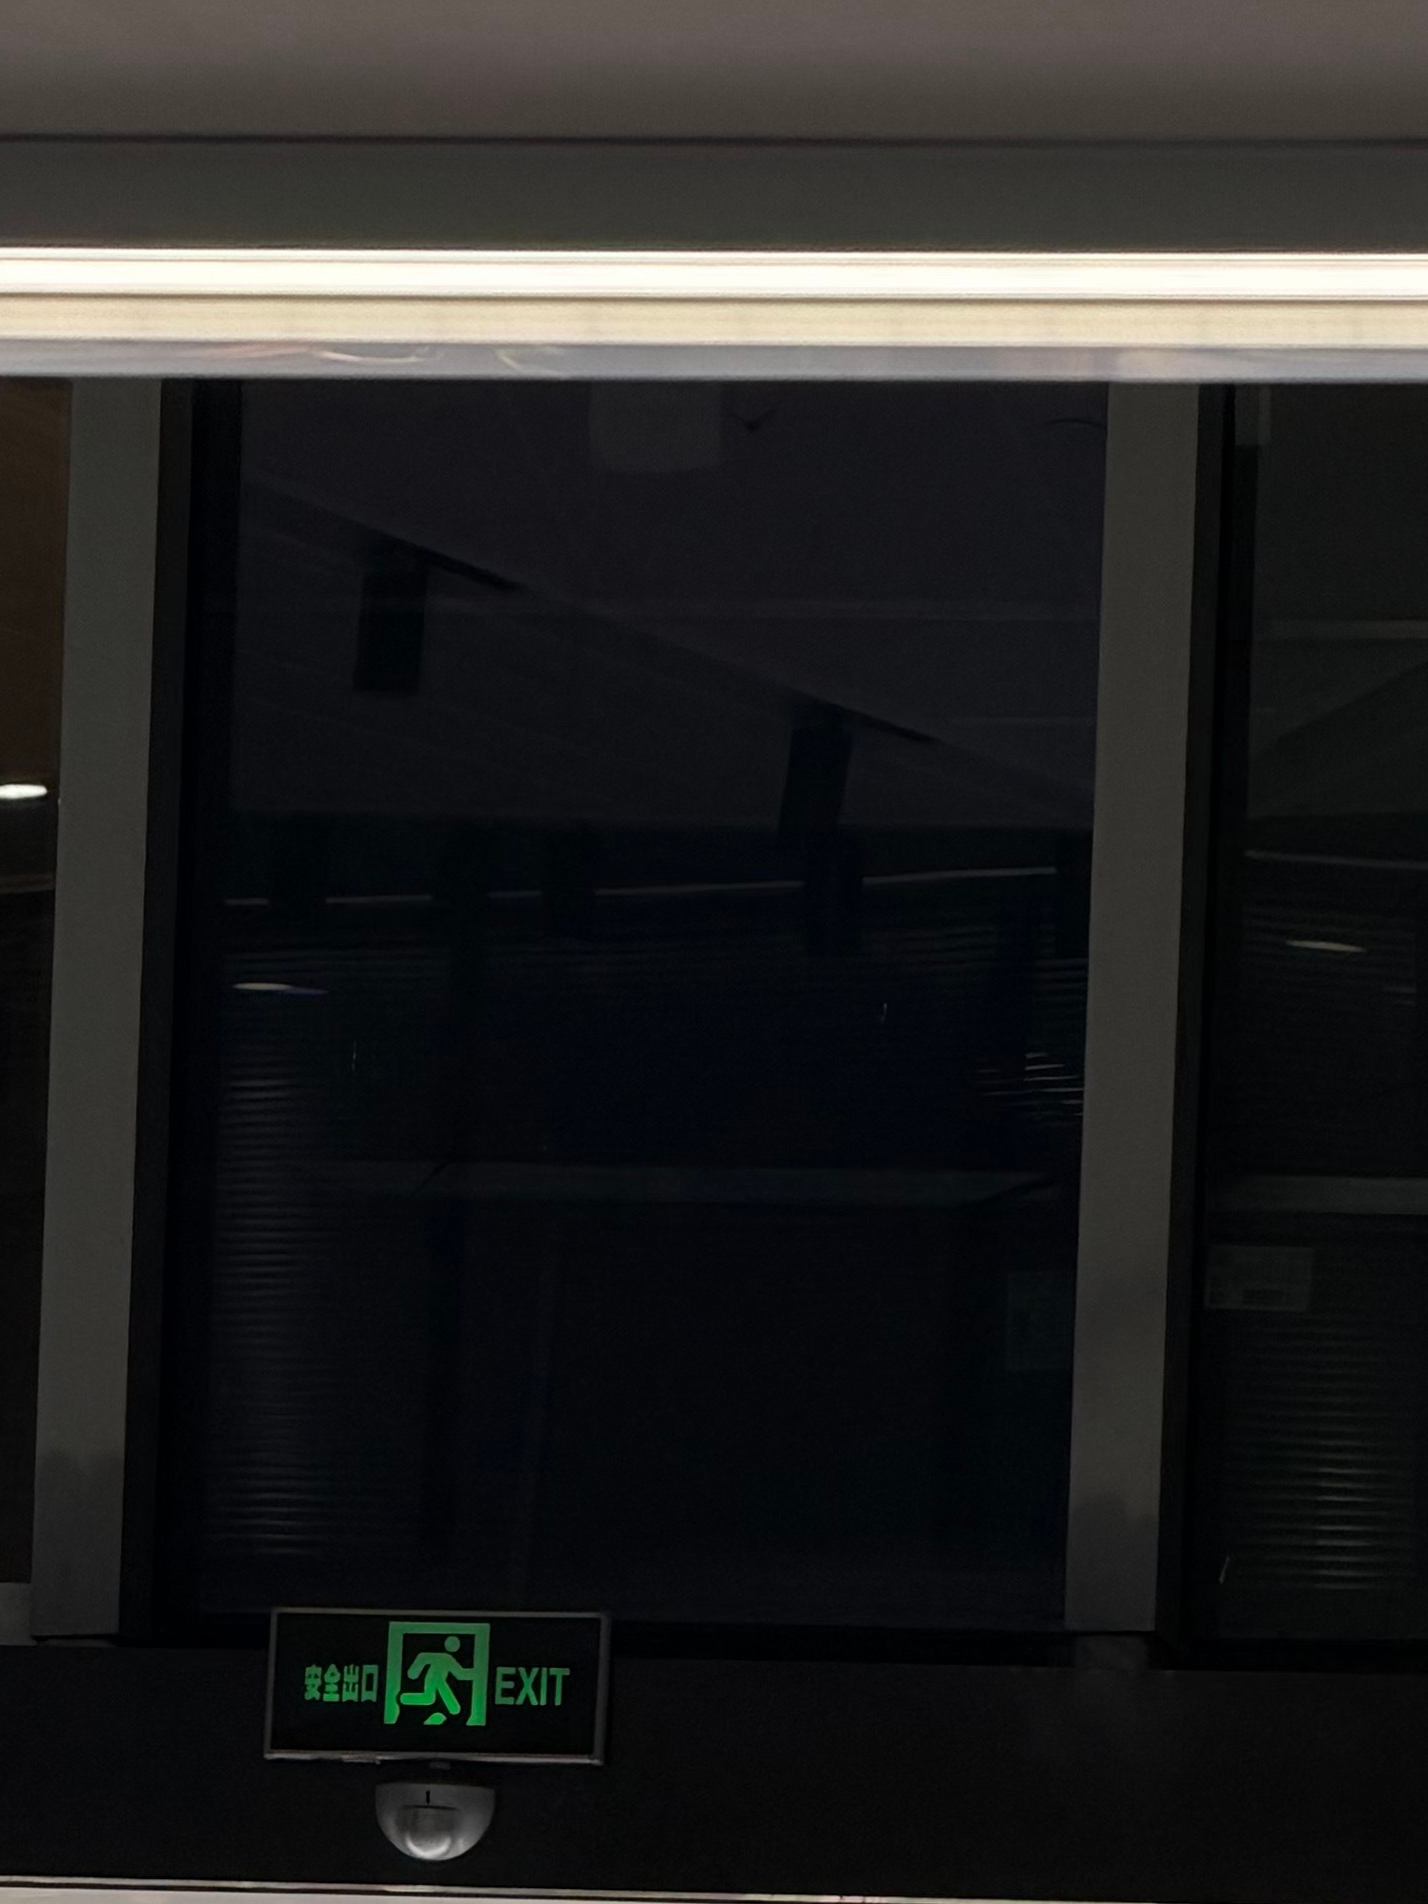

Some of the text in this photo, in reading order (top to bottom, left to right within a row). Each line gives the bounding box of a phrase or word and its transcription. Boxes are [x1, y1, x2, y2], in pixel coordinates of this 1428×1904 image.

[304, 1664, 379, 1703] 安全出口
[495, 1666, 570, 1706] EXIT
